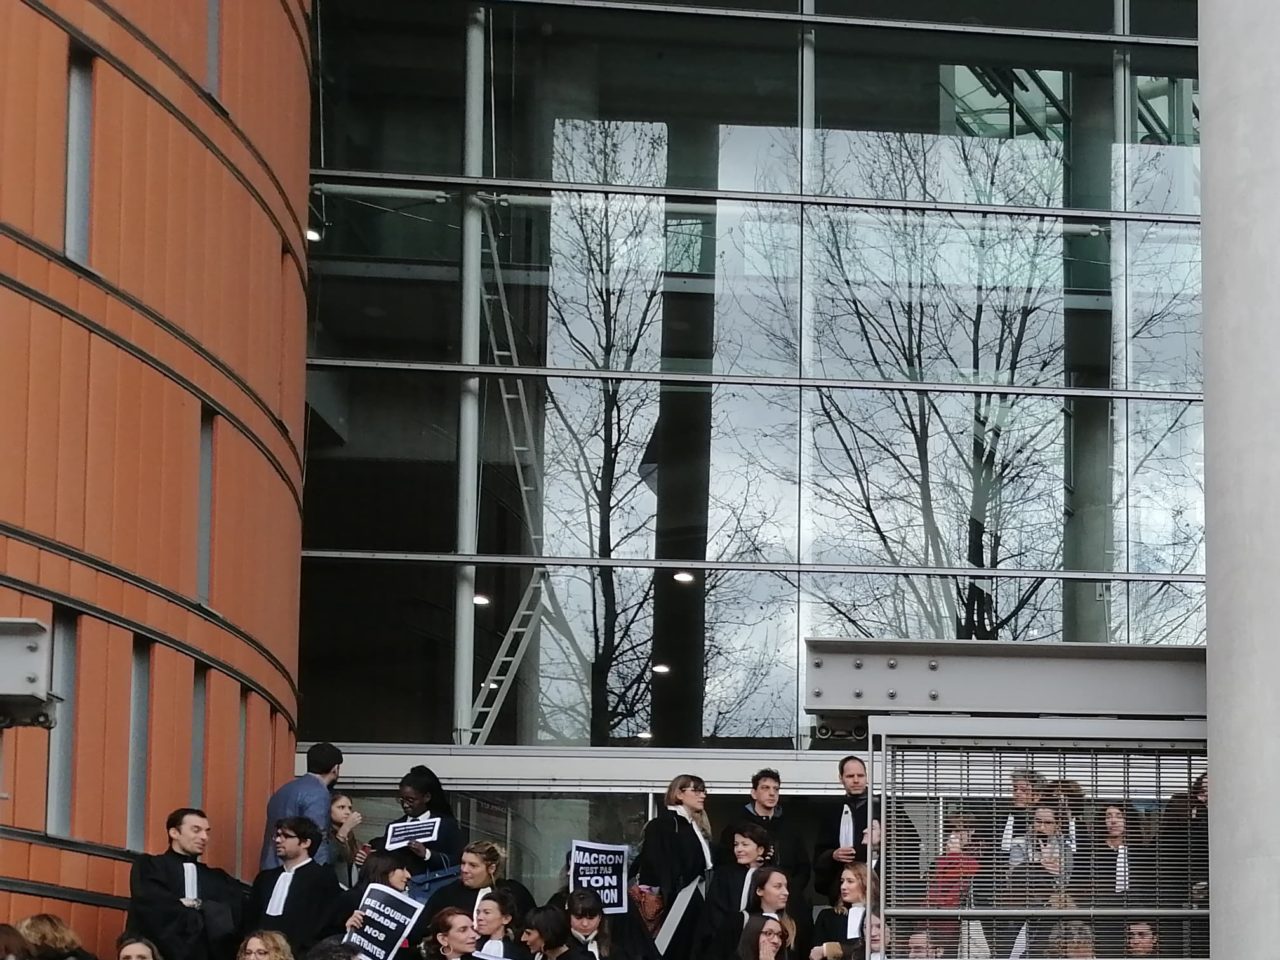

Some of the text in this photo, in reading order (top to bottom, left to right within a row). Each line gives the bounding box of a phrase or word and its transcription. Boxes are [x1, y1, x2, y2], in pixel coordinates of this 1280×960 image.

[574, 850, 623, 865] MACRON
[579, 866, 613, 875] C'EST PAS
[578, 875, 617, 887] TON
[364, 898, 412, 926] BELLOUBET
[365, 908, 398, 930] BRADE
[363, 925, 386, 941] NOS
[350, 932, 386, 960] RETRAITES
